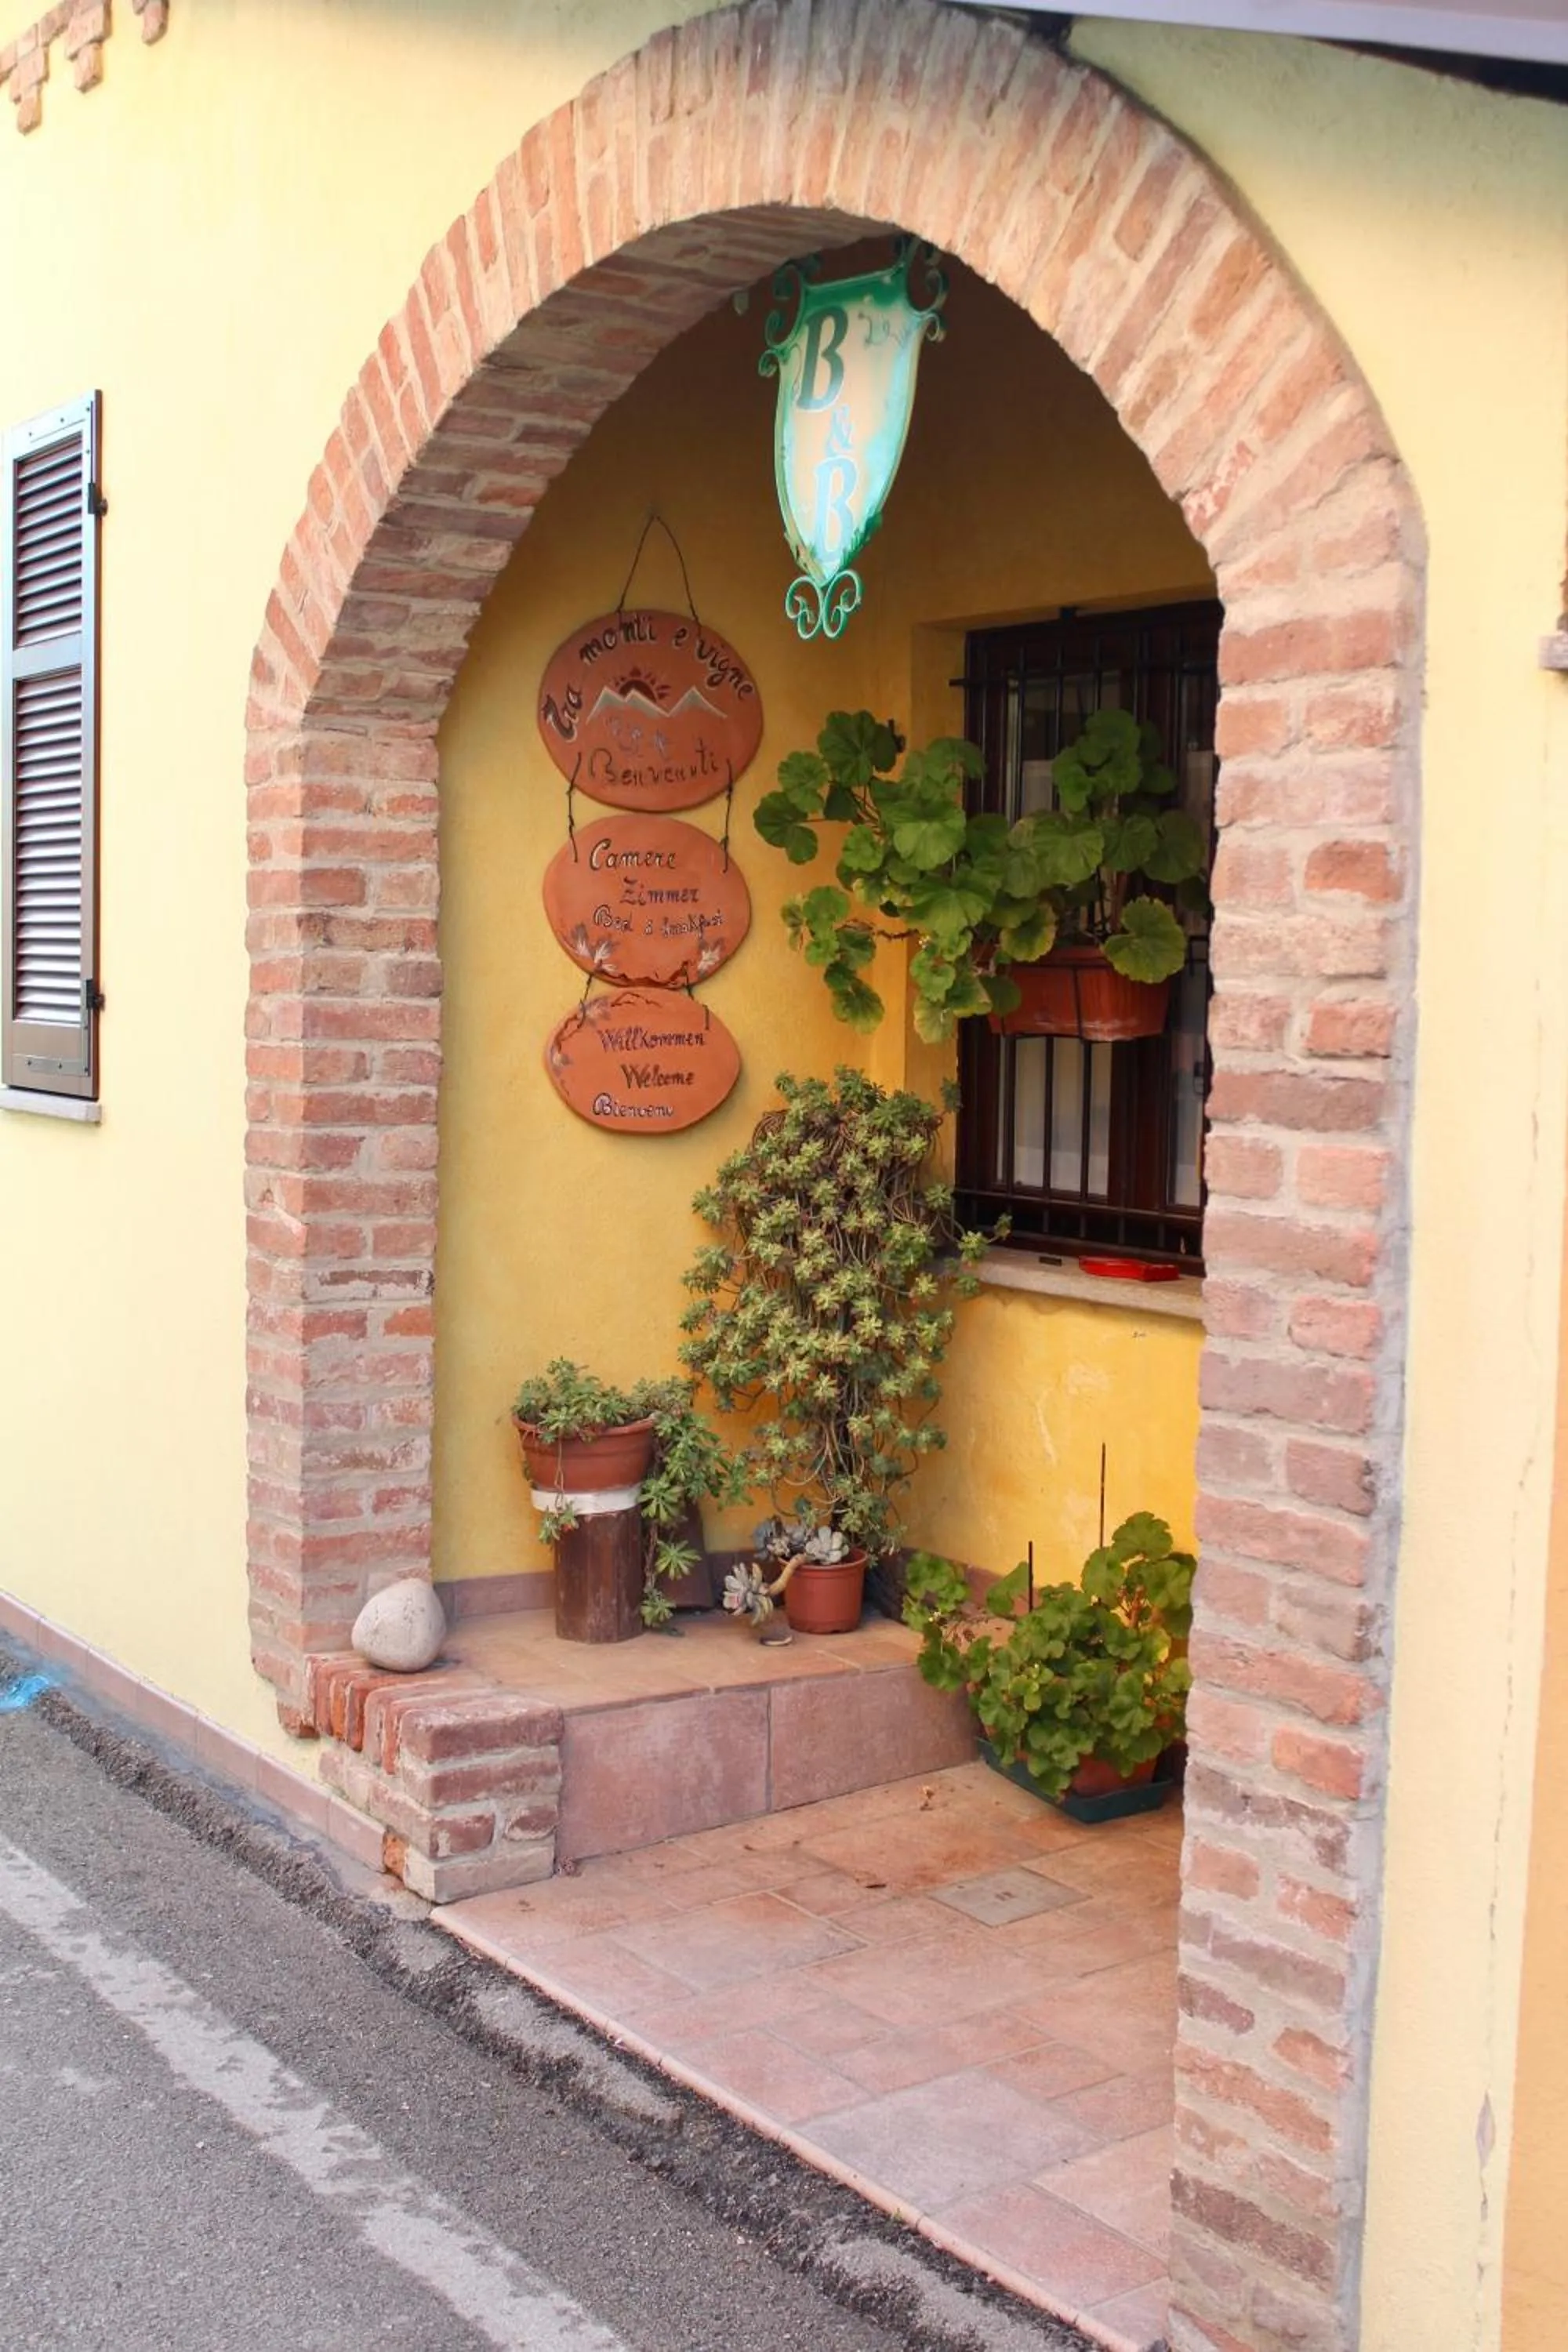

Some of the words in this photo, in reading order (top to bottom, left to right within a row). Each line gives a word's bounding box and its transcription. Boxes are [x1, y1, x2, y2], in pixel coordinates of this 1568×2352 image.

[796, 305, 848, 411] B
[813, 456, 857, 563] B
[579, 612, 657, 665] monti
[673, 626, 688, 647] e
[695, 638, 753, 701] vigne
[590, 738, 719, 786] Benvenuti
[590, 838, 677, 871] Camere
[619, 876, 700, 906] Zimmer
[593, 903, 633, 931] Bed
